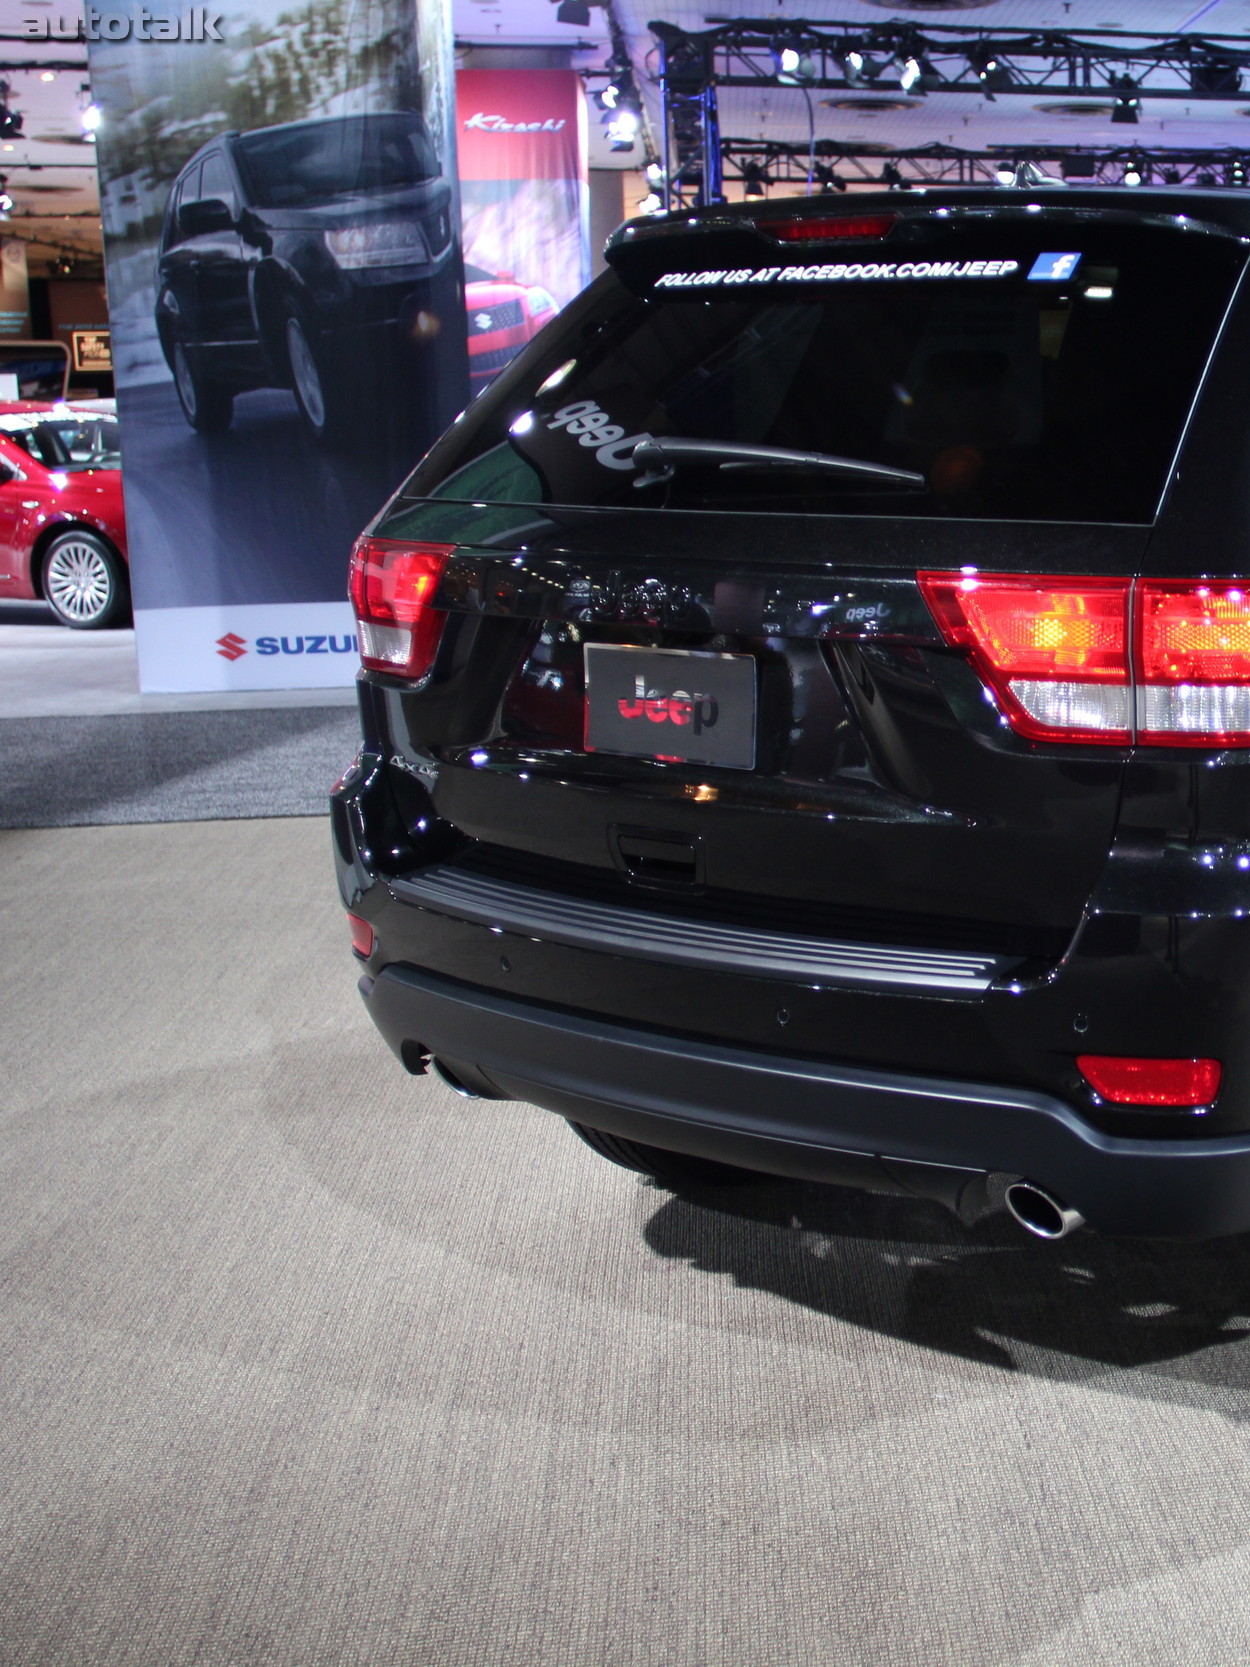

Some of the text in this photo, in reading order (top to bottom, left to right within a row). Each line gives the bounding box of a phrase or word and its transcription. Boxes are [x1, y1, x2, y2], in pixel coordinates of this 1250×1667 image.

[653, 269, 728, 287] FOLLOW
[723, 269, 753, 284] US
[749, 267, 781, 282] AT
[777, 260, 1018, 281] FACEBOOK.COM/JEEP
[256, 634, 358, 655] SUZU
[618, 675, 719, 735] Jeep
